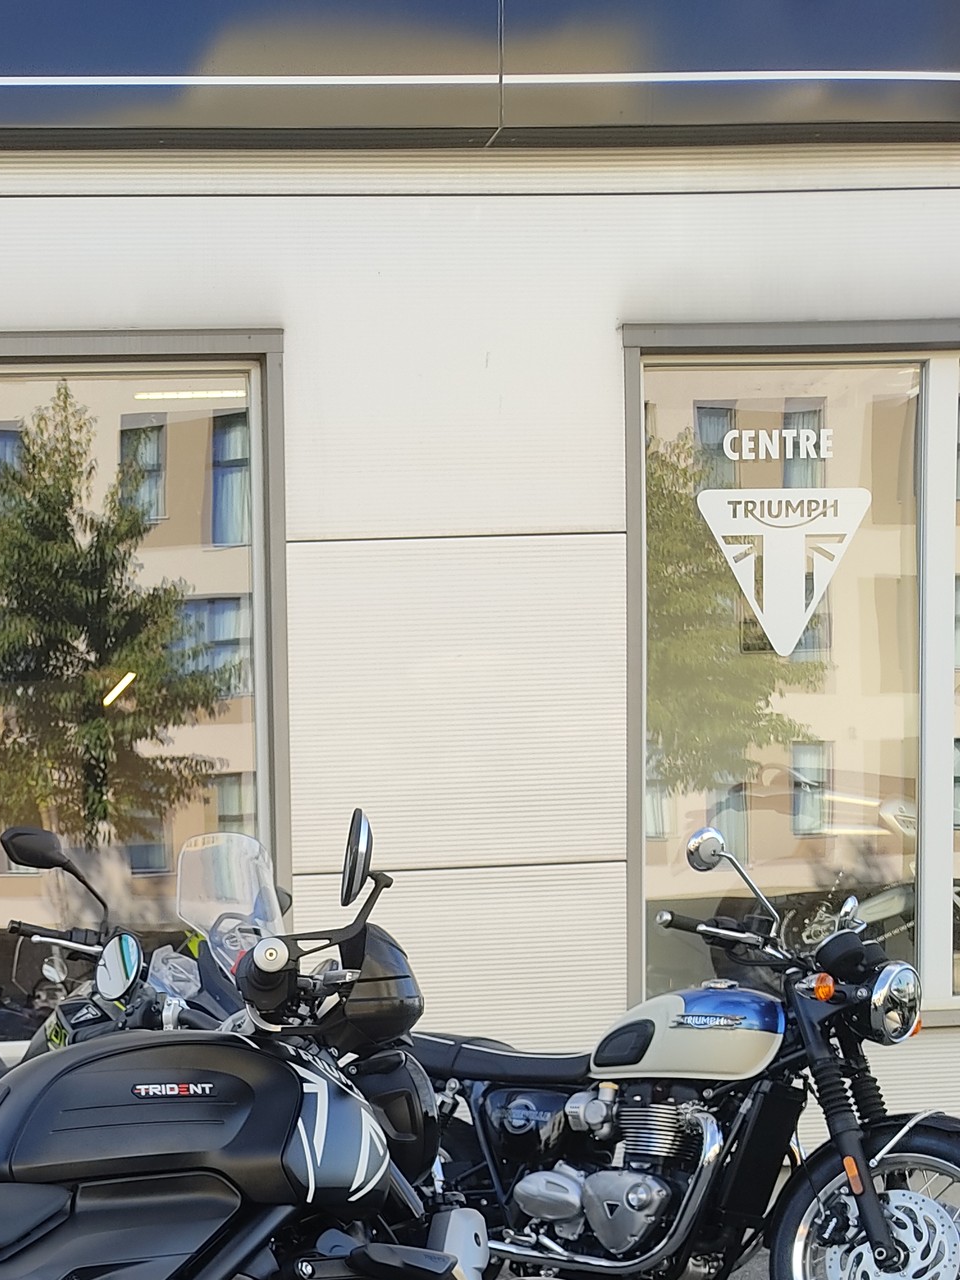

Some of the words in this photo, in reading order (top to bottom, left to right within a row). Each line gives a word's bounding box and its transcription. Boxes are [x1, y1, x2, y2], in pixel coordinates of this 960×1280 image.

[722, 428, 835, 461] CENTRE
[727, 498, 839, 524] TRIUMPH
[135, 1083, 214, 1096] TRIDENT
